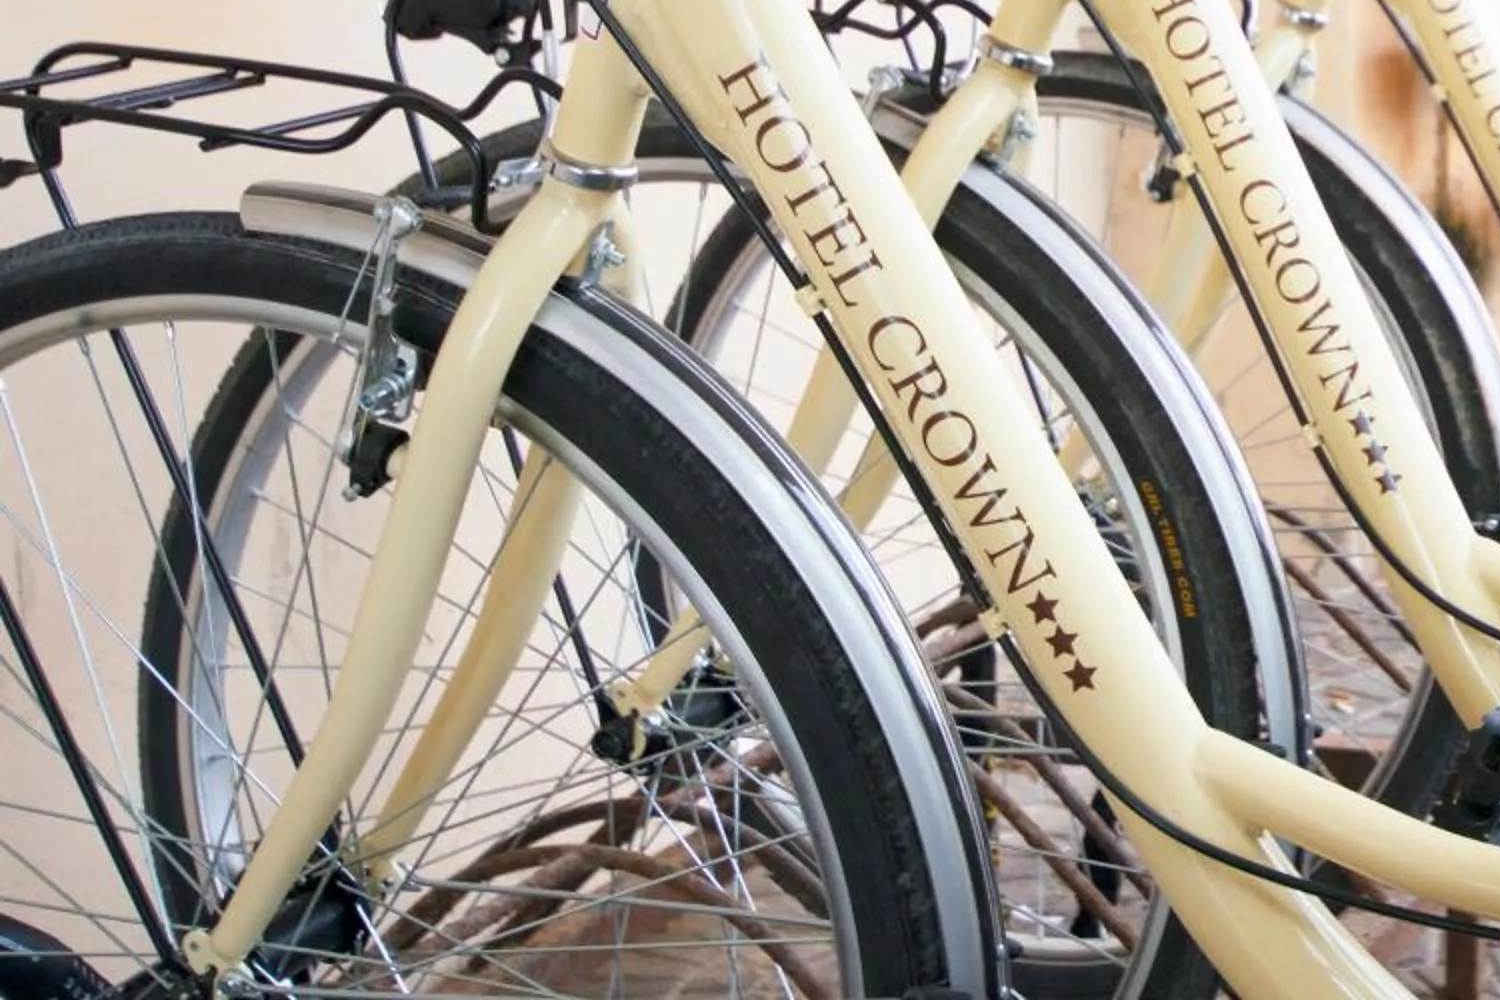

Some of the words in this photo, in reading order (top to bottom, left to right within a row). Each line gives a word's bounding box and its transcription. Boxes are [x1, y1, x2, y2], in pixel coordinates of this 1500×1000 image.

[717, 60, 884, 308] HOTEL
[866, 315, 1058, 598] CROWN
[1238, 178, 1378, 415] CROWN
